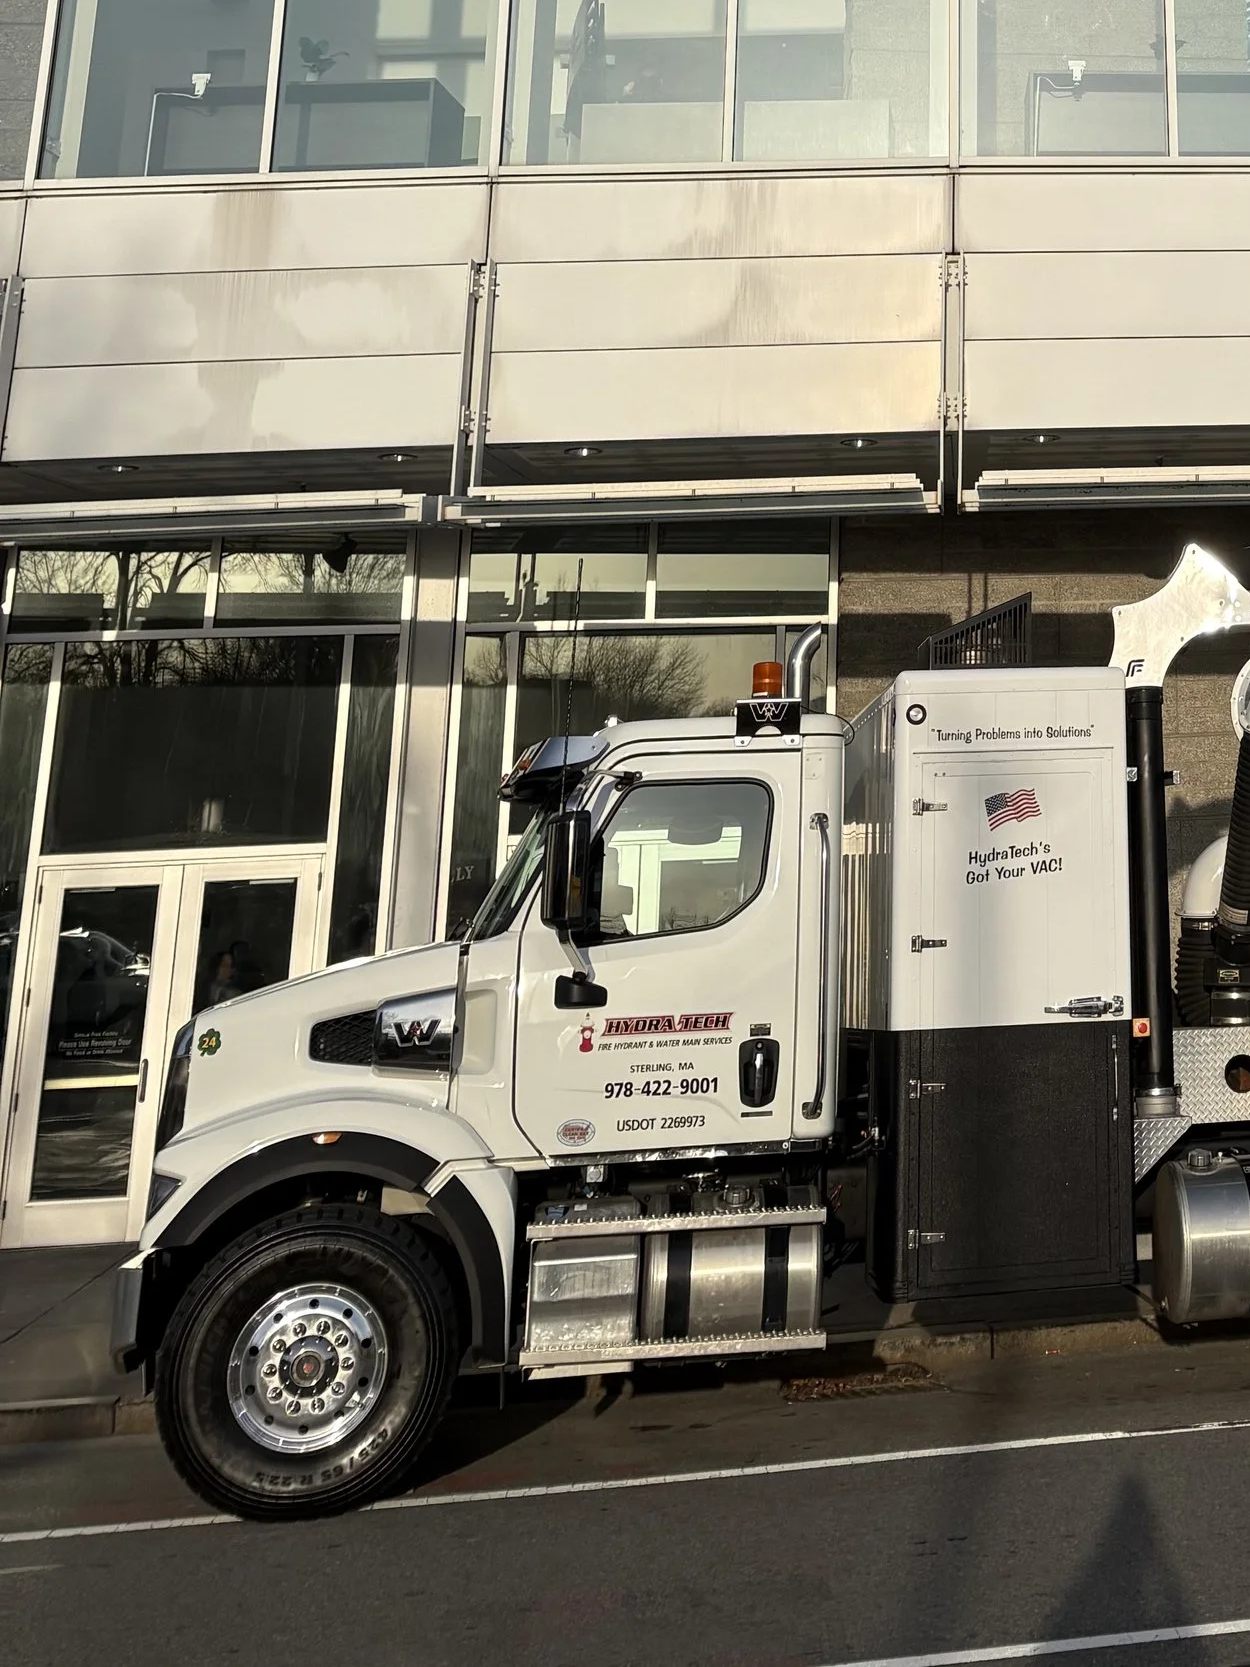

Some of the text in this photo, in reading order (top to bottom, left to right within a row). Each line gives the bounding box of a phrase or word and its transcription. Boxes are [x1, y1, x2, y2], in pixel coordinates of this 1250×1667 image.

[976, 728, 1020, 740] Problems
[1024, 728, 1043, 739] into
[968, 842, 1051, 868] HydraTech's
[966, 857, 1062, 884] Got Your VAC!
[202, 1036, 217, 1048] 24
[598, 1036, 732, 1052] FIRE HYDRANT & WATER MAIN SERVICES
[630, 1062, 694, 1074] STERLING, MA
[604, 1076, 718, 1099] 978-422-9001
[616, 1115, 706, 1132] USDOT 2269973
